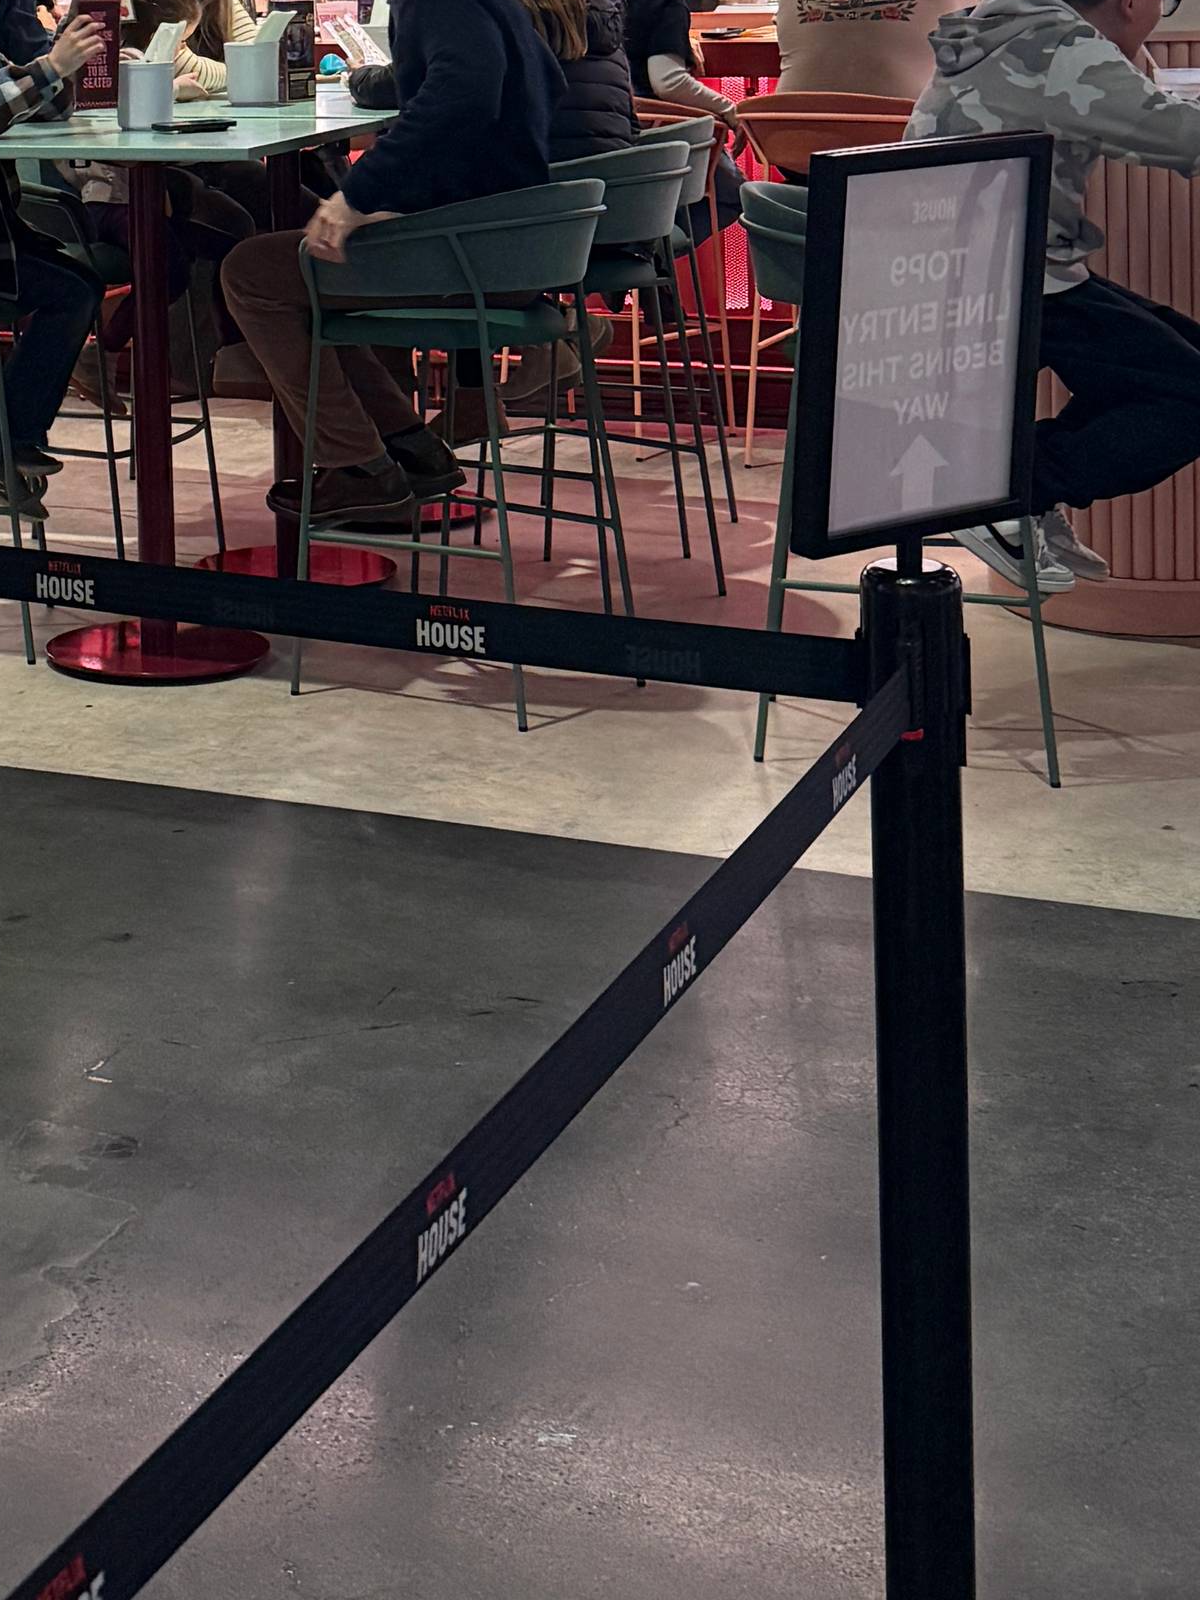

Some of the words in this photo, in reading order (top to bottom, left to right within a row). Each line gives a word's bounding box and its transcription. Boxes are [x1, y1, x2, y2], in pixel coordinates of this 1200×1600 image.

[82, 77, 112, 89] SEATED
[36, 572, 95, 605] HOUSE
[416, 618, 486, 654] HOUSE
[832, 753, 857, 811] HOUSE
[663, 935, 697, 1007] HOUSE
[417, 1187, 467, 1284] HOUSE
